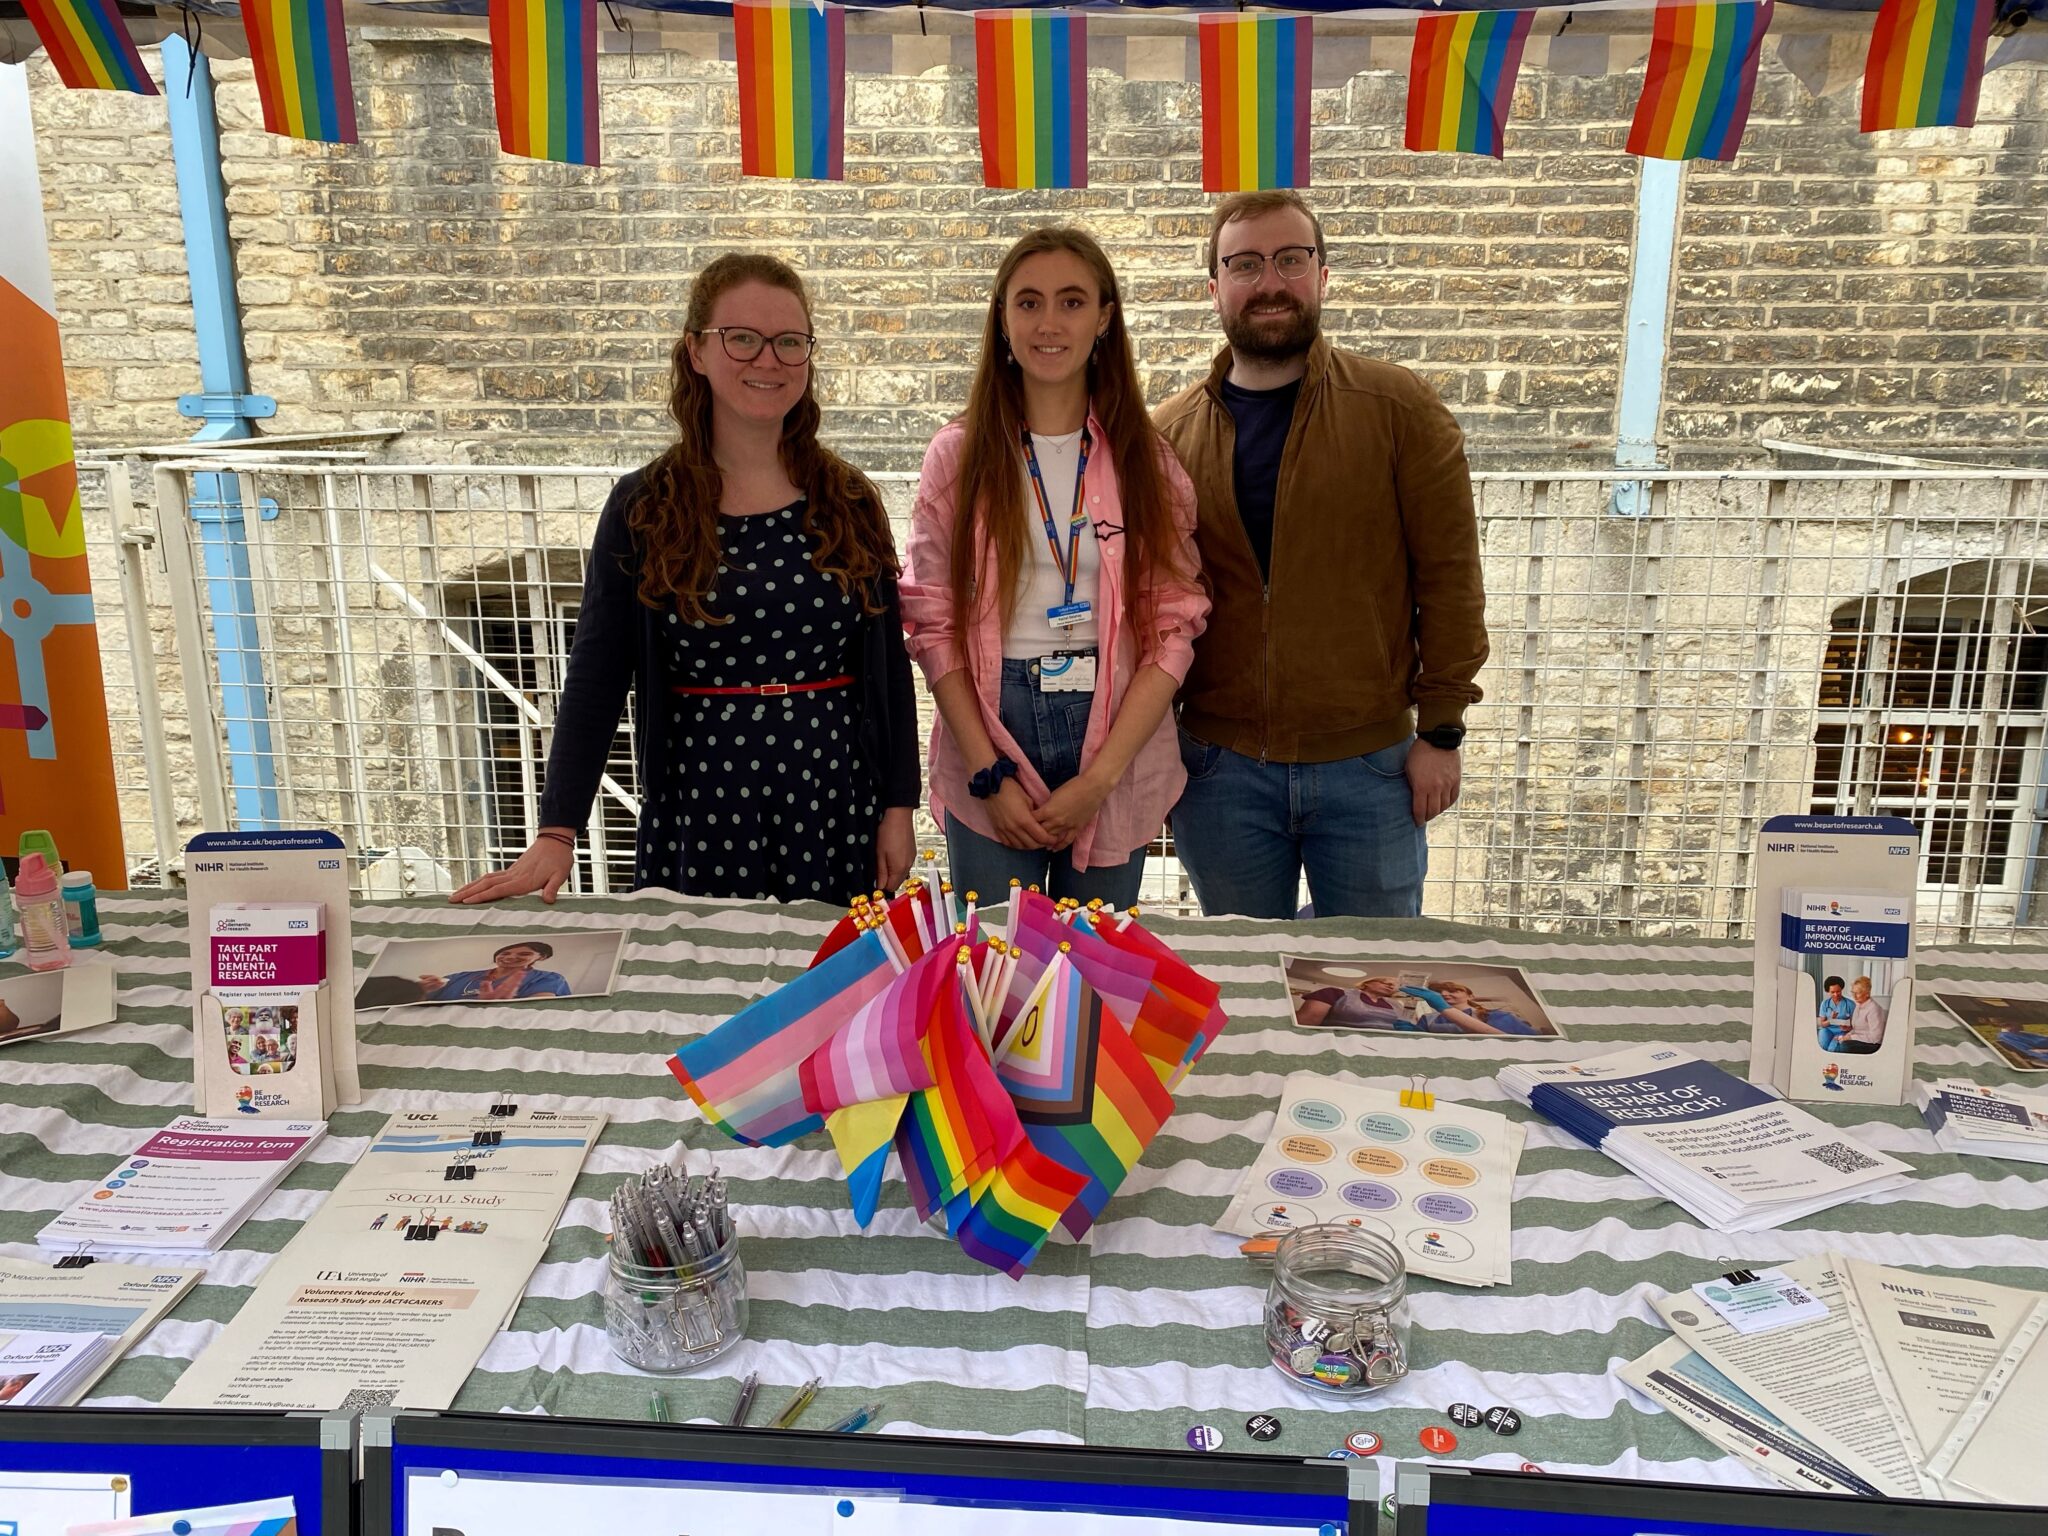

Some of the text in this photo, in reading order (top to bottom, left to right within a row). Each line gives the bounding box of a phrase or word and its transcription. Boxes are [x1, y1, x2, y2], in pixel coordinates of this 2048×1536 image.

[207, 838, 323, 847] www.nihr.ac.uk/bepartofresearch
[1768, 844, 1794, 852] NIHR
[195, 863, 224, 872] NIHR
[250, 944, 278, 952] PART
[1567, 1081, 1658, 1097] WHAT IS
[1587, 1085, 1703, 1108] BE PART OF
[1964, 1096, 1990, 1104] PART
[1607, 1096, 1727, 1120] RESEARCH?
[1950, 1099, 2010, 1113] IMPROVING
[1952, 1104, 1991, 1114] HEALTH
[1953, 1108, 1990, 1118] SOCIAL
[1689, 1122, 1730, 1134] Research
[1748, 1110, 1784, 1123] website
[1677, 1136, 1701, 1144] helps
[1730, 1129, 1750, 1137] find
[1750, 1123, 1769, 1132] and
[1768, 1118, 1790, 1127] take
[1699, 1139, 1728, 1148] health
[1728, 1137, 1748, 1145] and
[1748, 1131, 1773, 1141] social
[1773, 1126, 1795, 1136] care
[157, 1136, 295, 1149] Registration form
[1680, 1149, 1719, 1158] research
[1730, 1140, 1772, 1153] locations
[1771, 1136, 1795, 1146] near
[1793, 1132, 1814, 1141] you.
[386, 1192, 507, 1206] SOCIAL Study
[1881, 1282, 1926, 1297] NIHR
[1928, 1321, 1987, 1335] OXFORD
[1453, 1404, 1464, 1420] THEM
[1467, 1408, 1478, 1423] THEY
[1489, 1409, 1504, 1423] HIM
[1249, 1416, 1267, 1428] HIM
[1504, 1416, 1517, 1429] HE
[1262, 1424, 1276, 1435] HE
